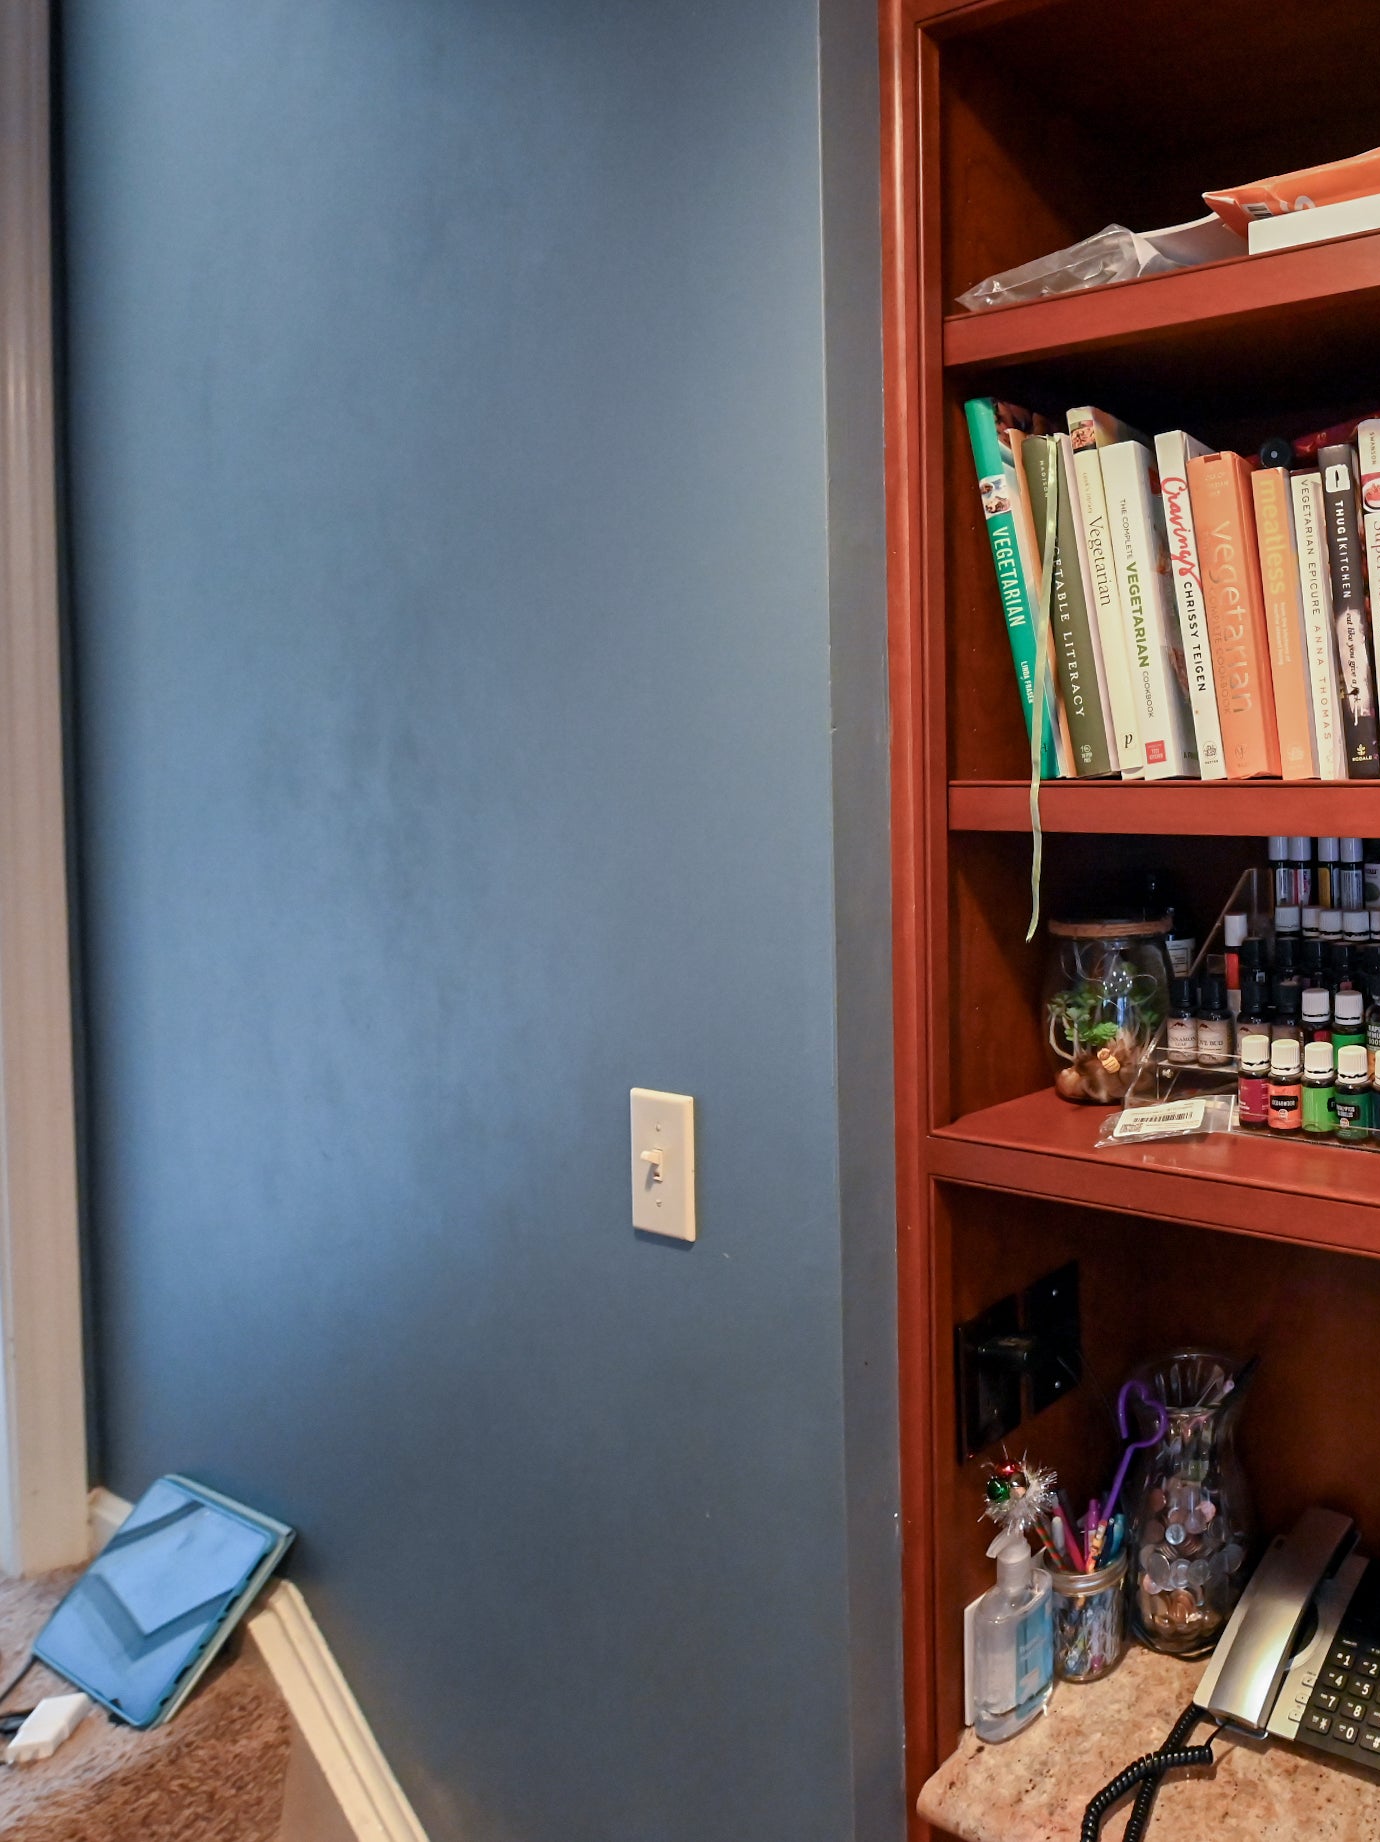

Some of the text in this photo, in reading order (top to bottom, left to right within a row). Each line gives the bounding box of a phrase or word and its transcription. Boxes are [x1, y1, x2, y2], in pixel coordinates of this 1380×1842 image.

[1368, 432, 1377, 465] SWANSON
[1161, 477, 1201, 588] Cravings
[1259, 479, 1286, 596] meatless
[1335, 500, 1352, 600] THUG KITCHEN
[1088, 516, 1111, 606] Vegetarian
[992, 526, 1026, 628] VEGETARIAN
[1120, 498, 1153, 719] THE COMPLETE VEGETARIAN COOKBOOK
[1300, 480, 1332, 740] VEGETARIAN EPICURE ANNA THOMAS
[1054, 546, 1085, 717] ETABLE LITERACY
[1184, 581, 1206, 692] CHRISSY TEIGEN
[1347, 627, 1355, 642] like
[1346, 642, 1355, 658] you
[1021, 661, 1030, 679] LINDA
[1348, 660, 1357, 678] give
[1343, 1655, 1351, 1666] 1
[1368, 1664, 1378, 1674] 2
[1335, 1675, 1343, 1687] 4
[1361, 1683, 1370, 1695] 5
[1328, 1696, 1336, 1707] 7
[1353, 1705, 1362, 1717] 8
[1346, 1727, 1355, 1739] 0
